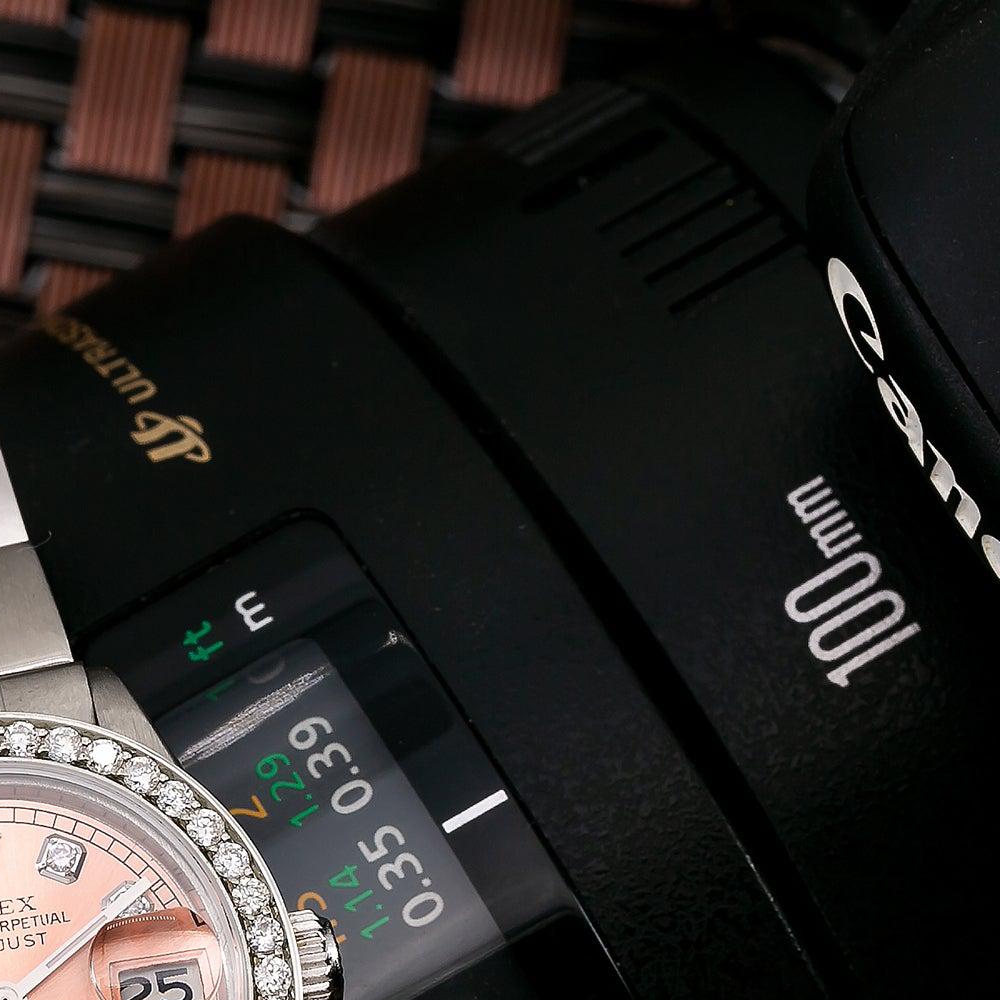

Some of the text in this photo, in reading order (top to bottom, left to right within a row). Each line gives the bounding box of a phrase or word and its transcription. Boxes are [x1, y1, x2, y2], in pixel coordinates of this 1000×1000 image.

[234, 591, 274, 632] m
[784, 475, 921, 687] 100mm
[183, 619, 224, 662] ft
[255, 752, 320, 827] 1.29
[288, 716, 373, 815] 0.39
[328, 865, 390, 940] 1.14
[357, 825, 445, 927] 0.35
